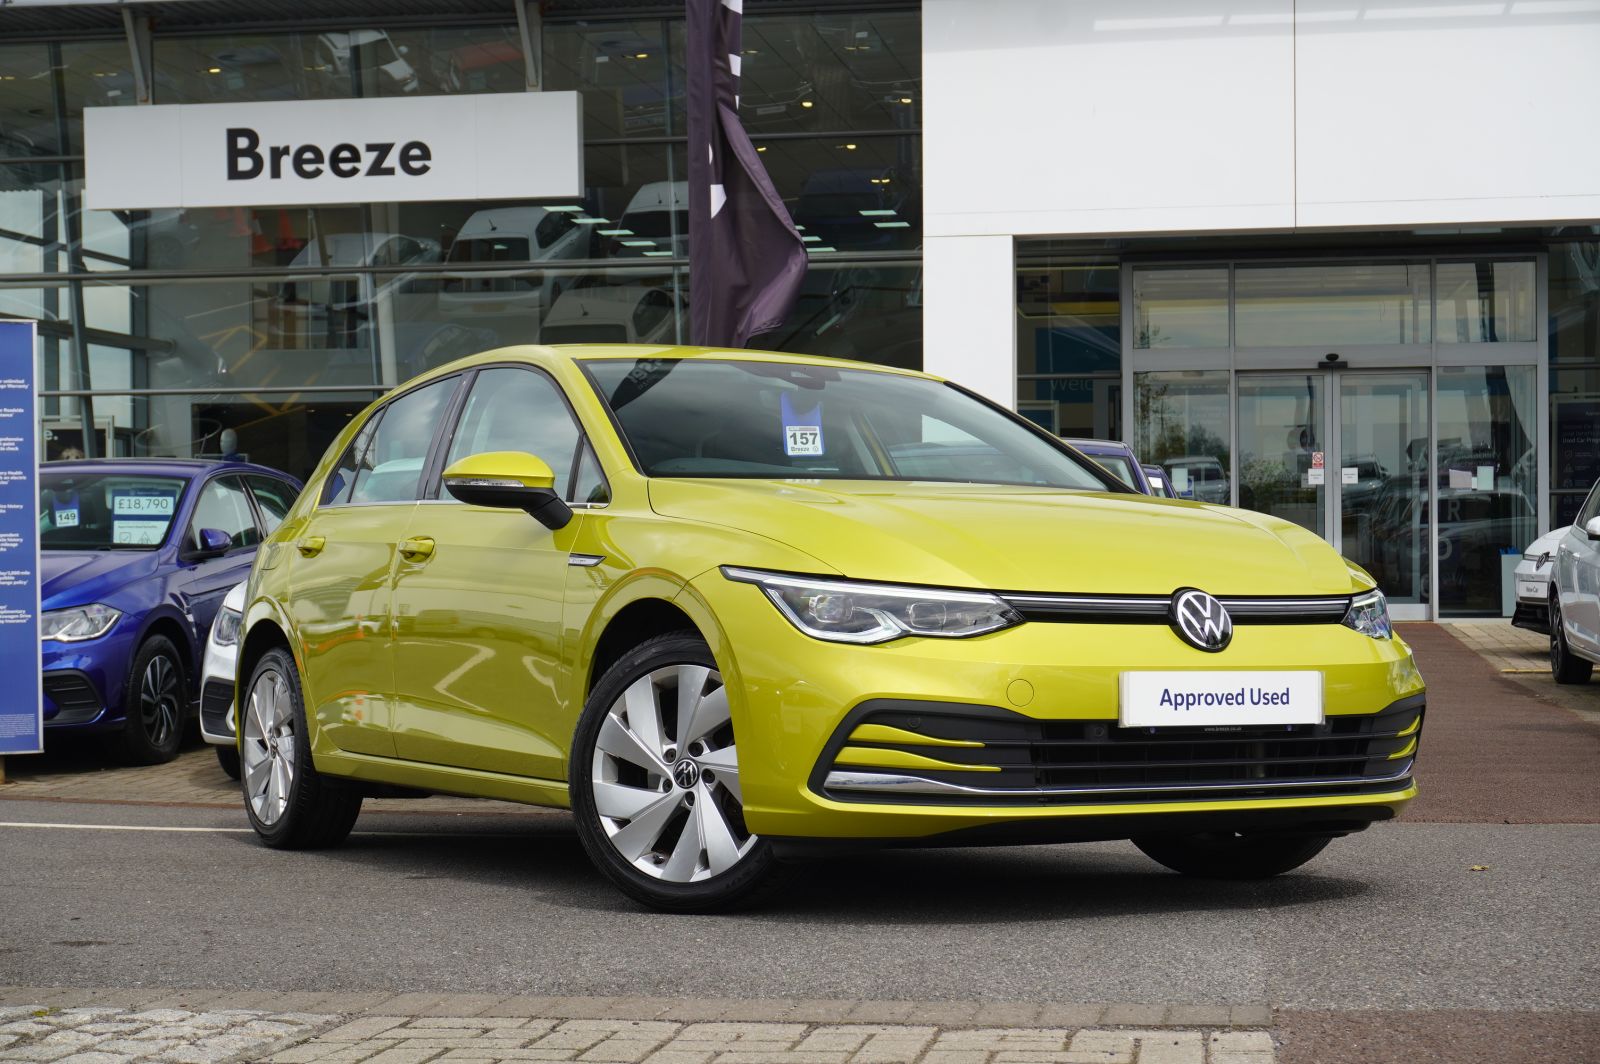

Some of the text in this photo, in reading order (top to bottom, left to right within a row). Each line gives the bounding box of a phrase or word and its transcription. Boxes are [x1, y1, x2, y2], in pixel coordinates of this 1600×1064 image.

[226, 127, 432, 180] Breeze
[790, 432, 818, 445] 157
[118, 498, 168, 511] £18,790
[58, 512, 76, 521] 149
[1160, 687, 1289, 710] Approved Used
